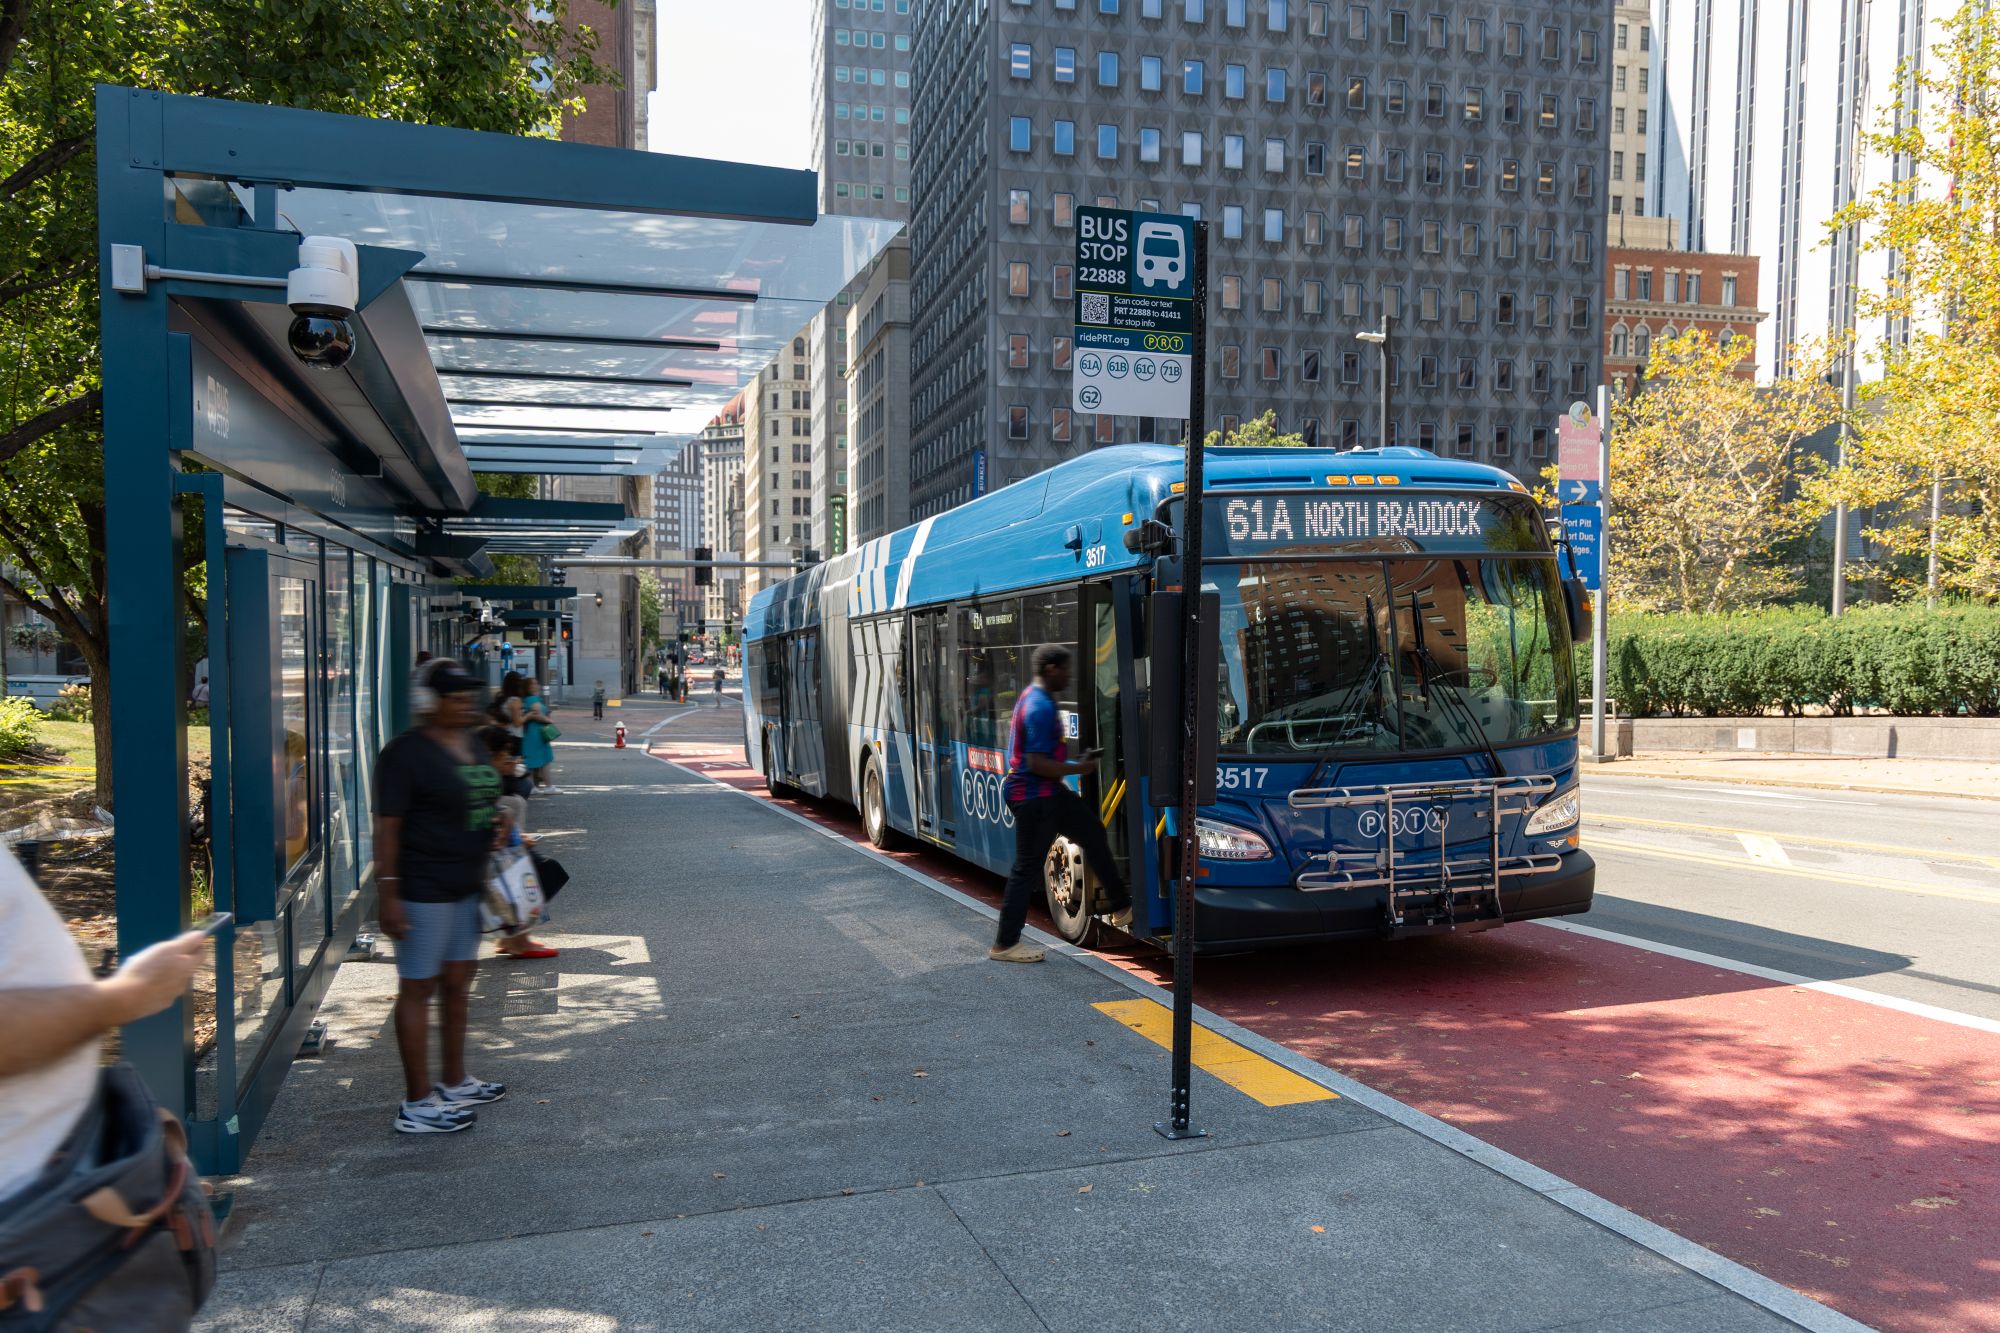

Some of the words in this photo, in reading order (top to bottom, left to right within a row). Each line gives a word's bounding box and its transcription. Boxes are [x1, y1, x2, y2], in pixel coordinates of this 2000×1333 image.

[1081, 215, 1128, 242] BUS
[1080, 242, 1128, 262] STOP
[1079, 266, 1126, 285] 22888
[1114, 296, 1130, 305] Scan
[1131, 299, 1150, 307] code
[1114, 307, 1128, 315] PRT
[1129, 308, 1151, 317] 22888
[1160, 310, 1181, 319] 41411
[1114, 317, 1125, 325] for
[1125, 319, 1140, 328] stop
[1141, 319, 1156, 328] info
[1079, 332, 1130, 346] ridePRT.org
[1147, 337, 1181, 349] PRT
[1081, 360, 1100, 371] 61A
[1109, 361, 1127, 372] 61B
[1135, 363, 1154, 375] 61C
[1162, 365, 1180, 377] 71B
[1081, 390, 1099, 404] G2
[1227, 499, 1294, 540] 61A
[1304, 501, 1369, 536] NORTH
[1377, 501, 1481, 536] BRADDOCK
[1563, 518, 1578, 528] Fort
[1579, 518, 1592, 528] Pitt
[1086, 544, 1106, 568] 3517
